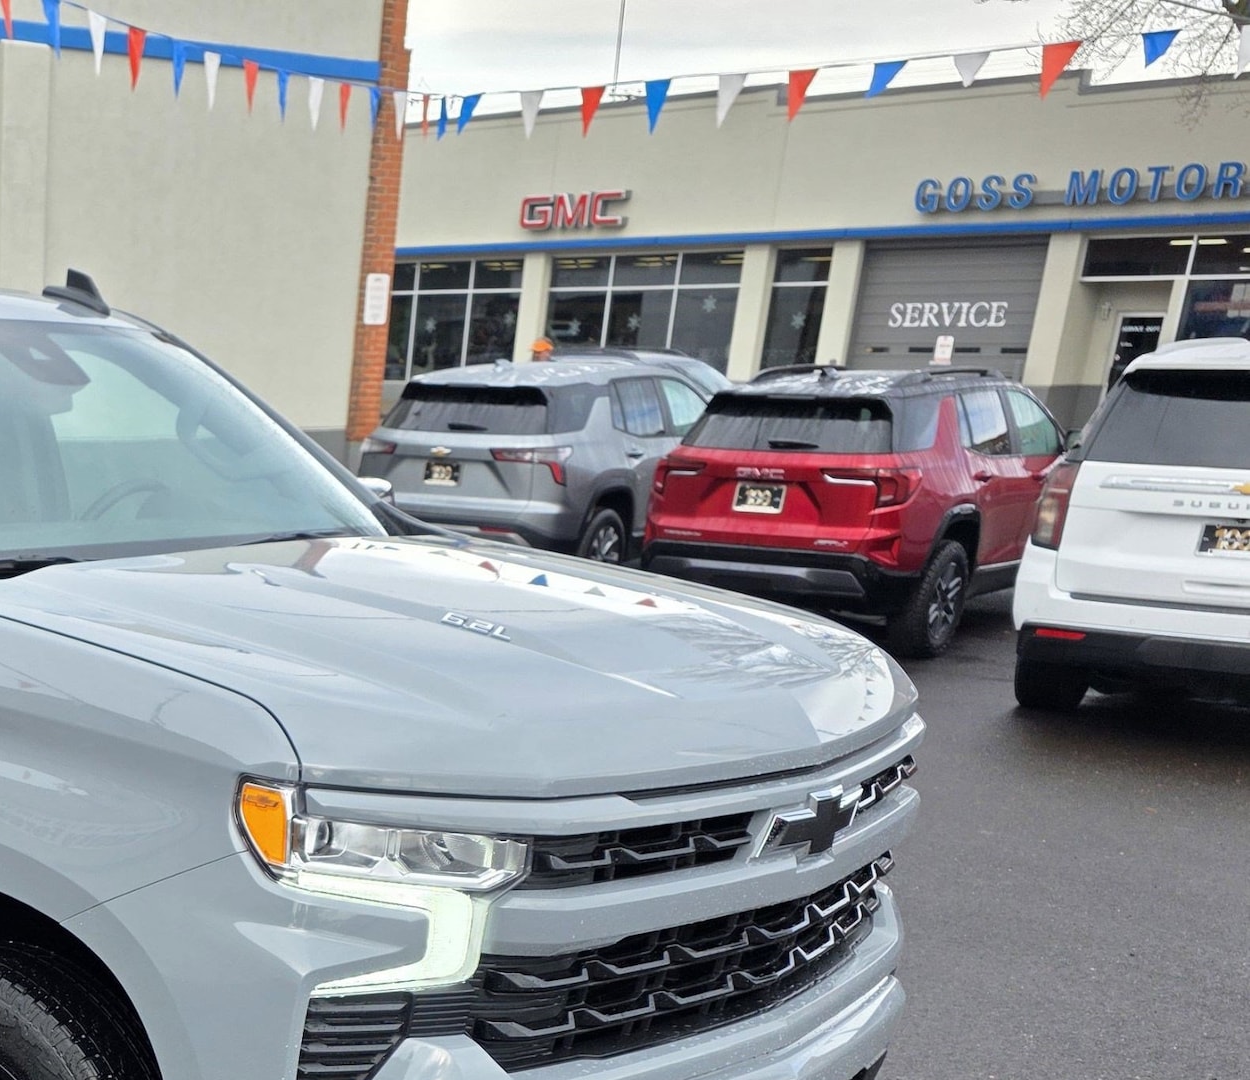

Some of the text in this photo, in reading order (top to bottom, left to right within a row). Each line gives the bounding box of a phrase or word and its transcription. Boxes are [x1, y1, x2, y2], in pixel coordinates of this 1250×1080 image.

[914, 160, 1246, 214] GOSS MOTOR
[519, 190, 628, 231] GMC
[888, 301, 1009, 328] SERVICE
[736, 466, 785, 480] GMC
[1172, 499, 1250, 511] SUBU
[441, 611, 511, 643] 6.2L
